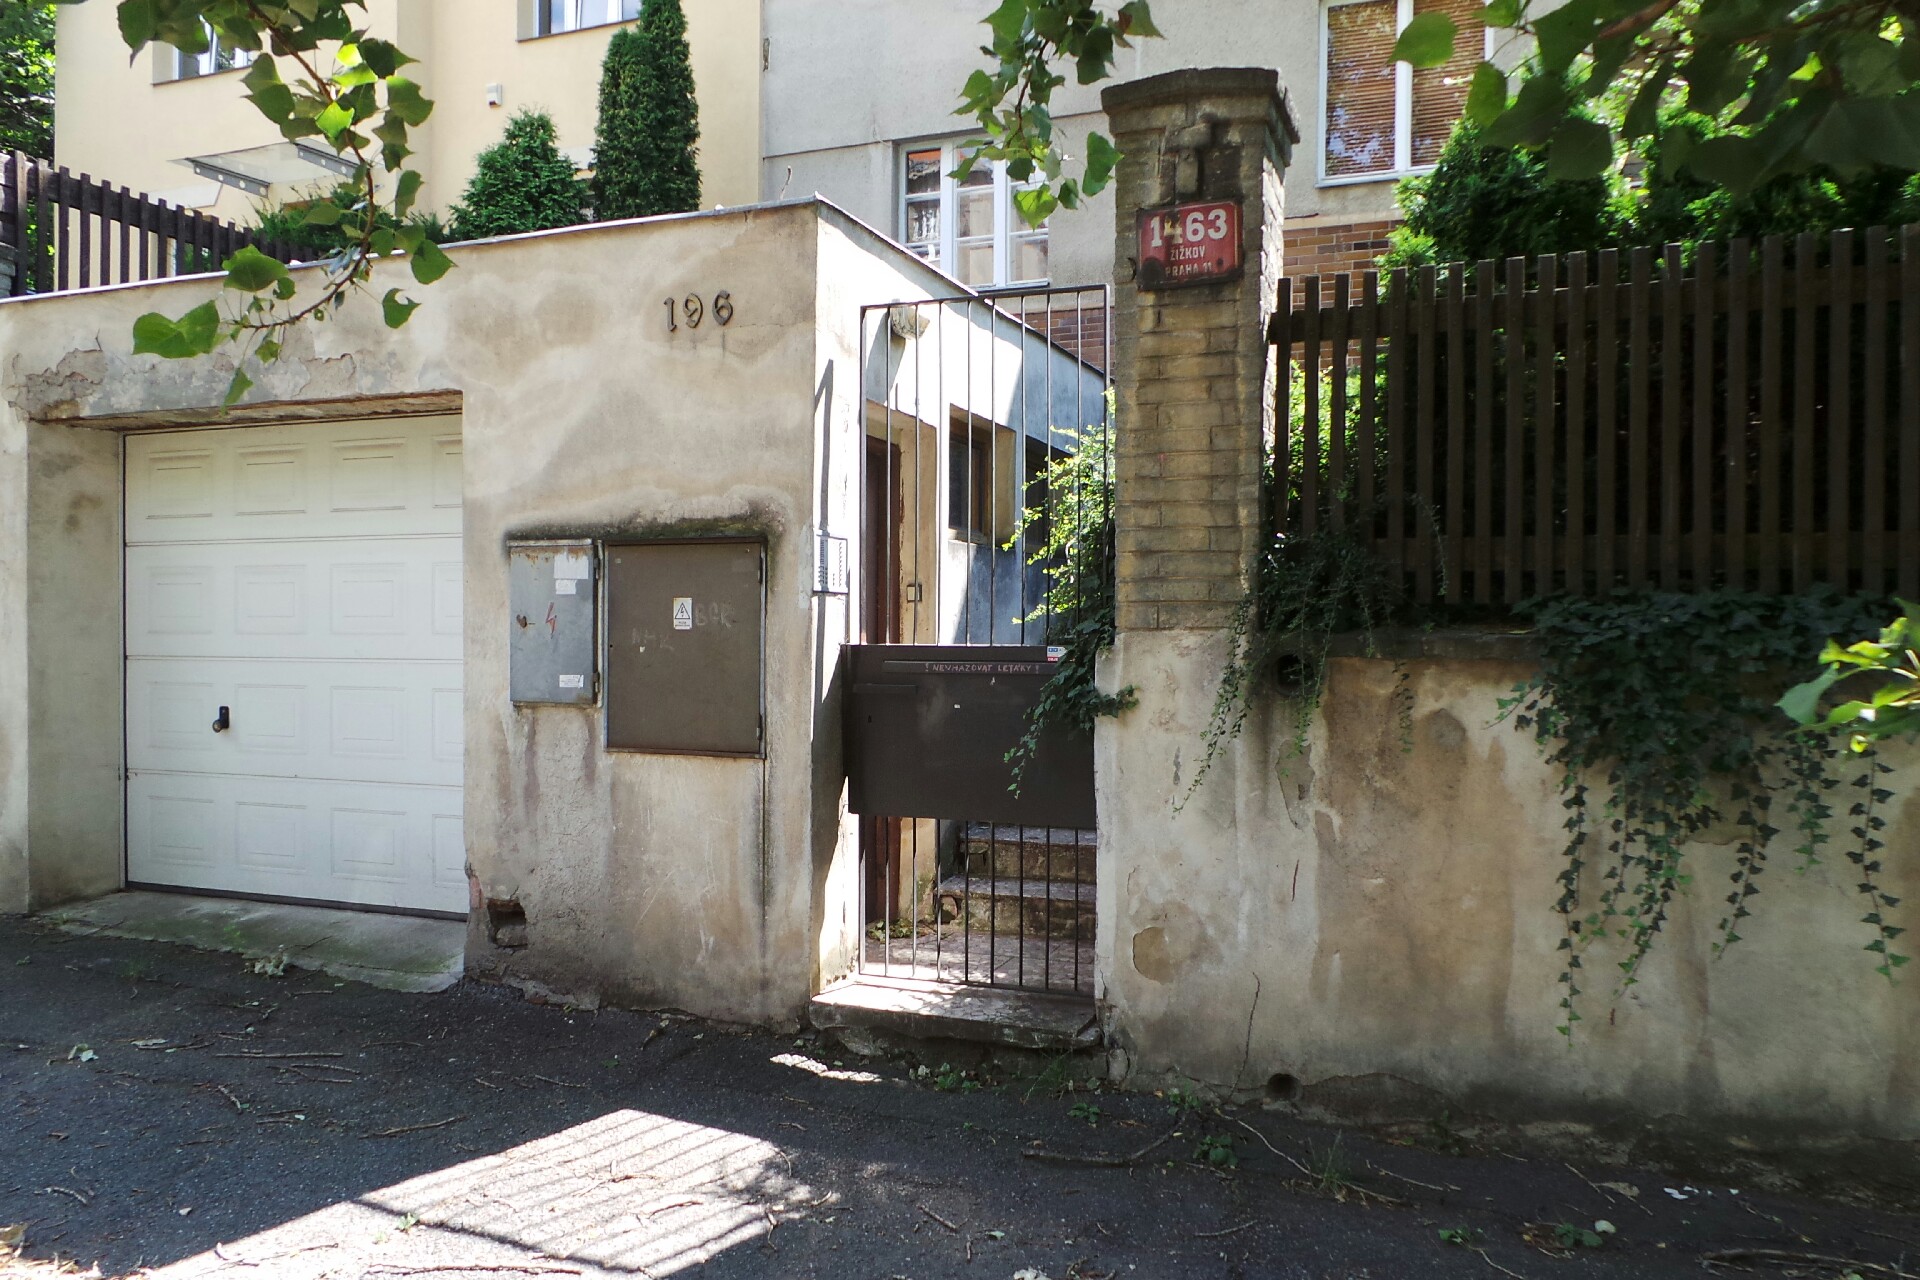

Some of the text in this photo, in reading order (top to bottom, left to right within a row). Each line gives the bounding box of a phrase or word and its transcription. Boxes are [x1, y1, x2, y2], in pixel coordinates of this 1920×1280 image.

[1151, 209, 1227, 247] 1463
[1170, 245, 1205, 260] ŽIŽKOV
[1165, 262, 1212, 277] PRAHA 11
[664, 290, 734, 332] 196
